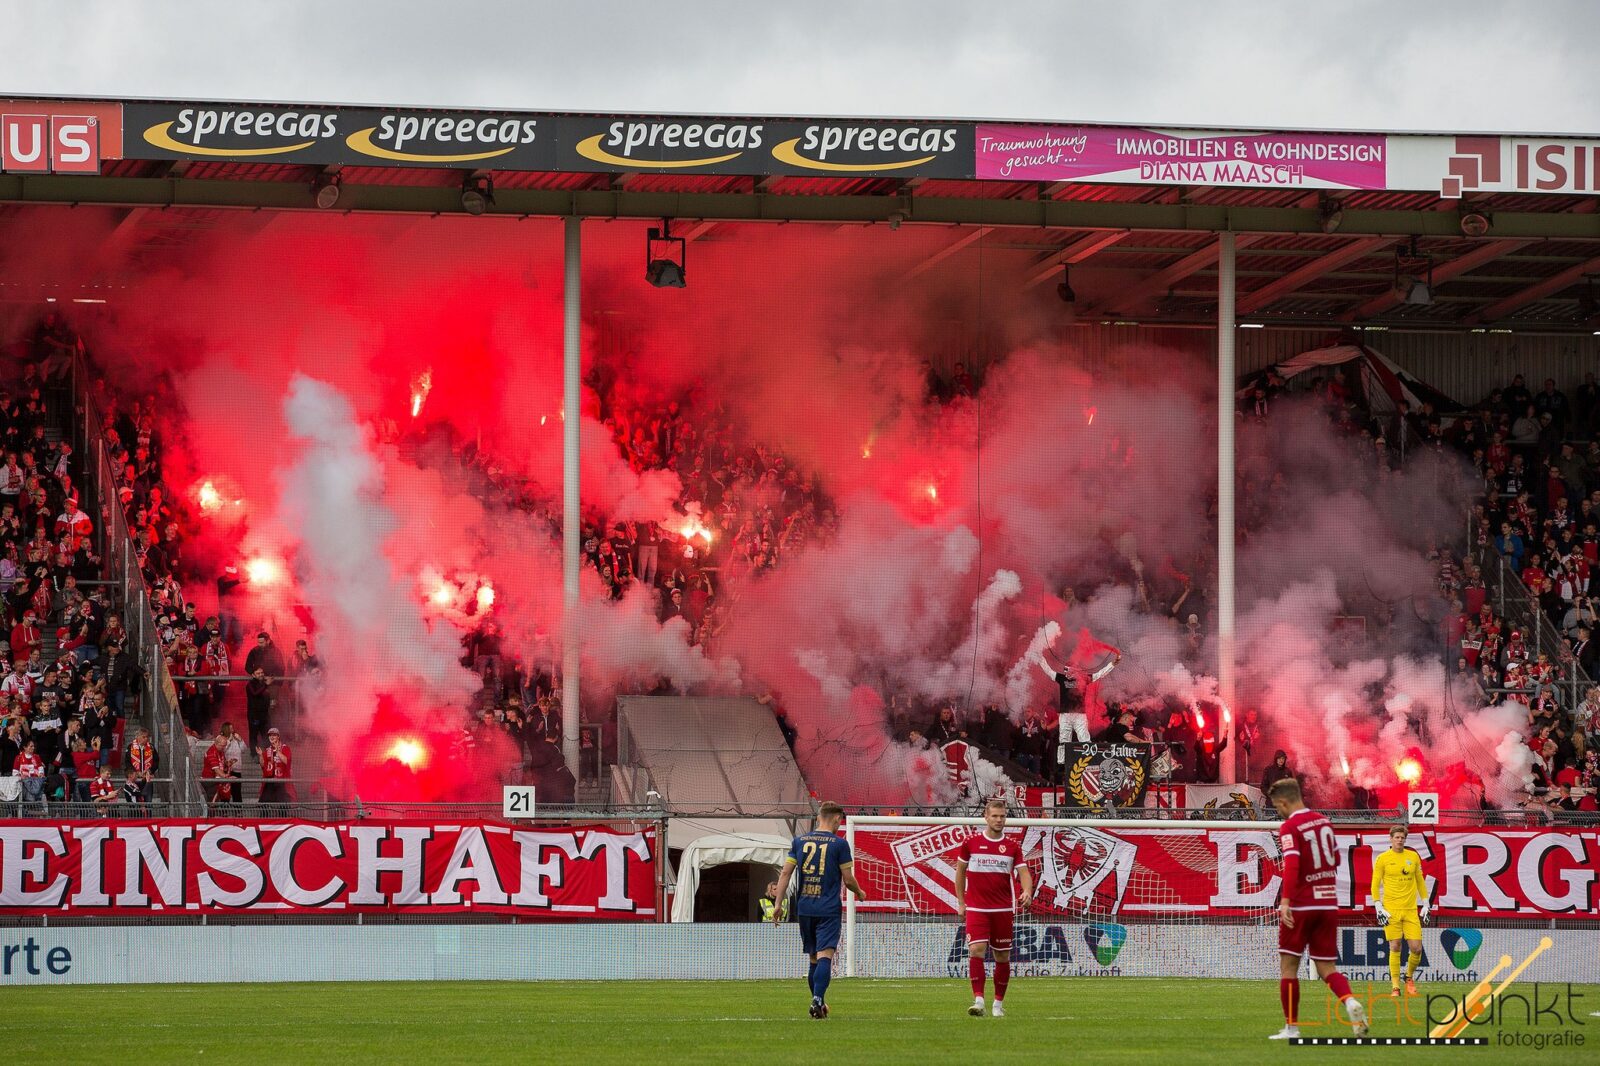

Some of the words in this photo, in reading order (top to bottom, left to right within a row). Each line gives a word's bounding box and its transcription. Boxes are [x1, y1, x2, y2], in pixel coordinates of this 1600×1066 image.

[980, 132, 1087, 154] Traumwohnung
[1116, 138, 1227, 158] IMMOBILIEN
[1233, 141, 1248, 159] &
[1254, 142, 1382, 162] WOHNDESIGN
[1140, 161, 1207, 182] DIANA
[1213, 163, 1304, 185] MAASCH
[509, 791, 530, 812] 21
[1411, 798, 1435, 818] 22
[802, 841, 828, 876] 21
[1302, 825, 1336, 870] 10
[0, 824, 652, 913] EINSCHAFT
